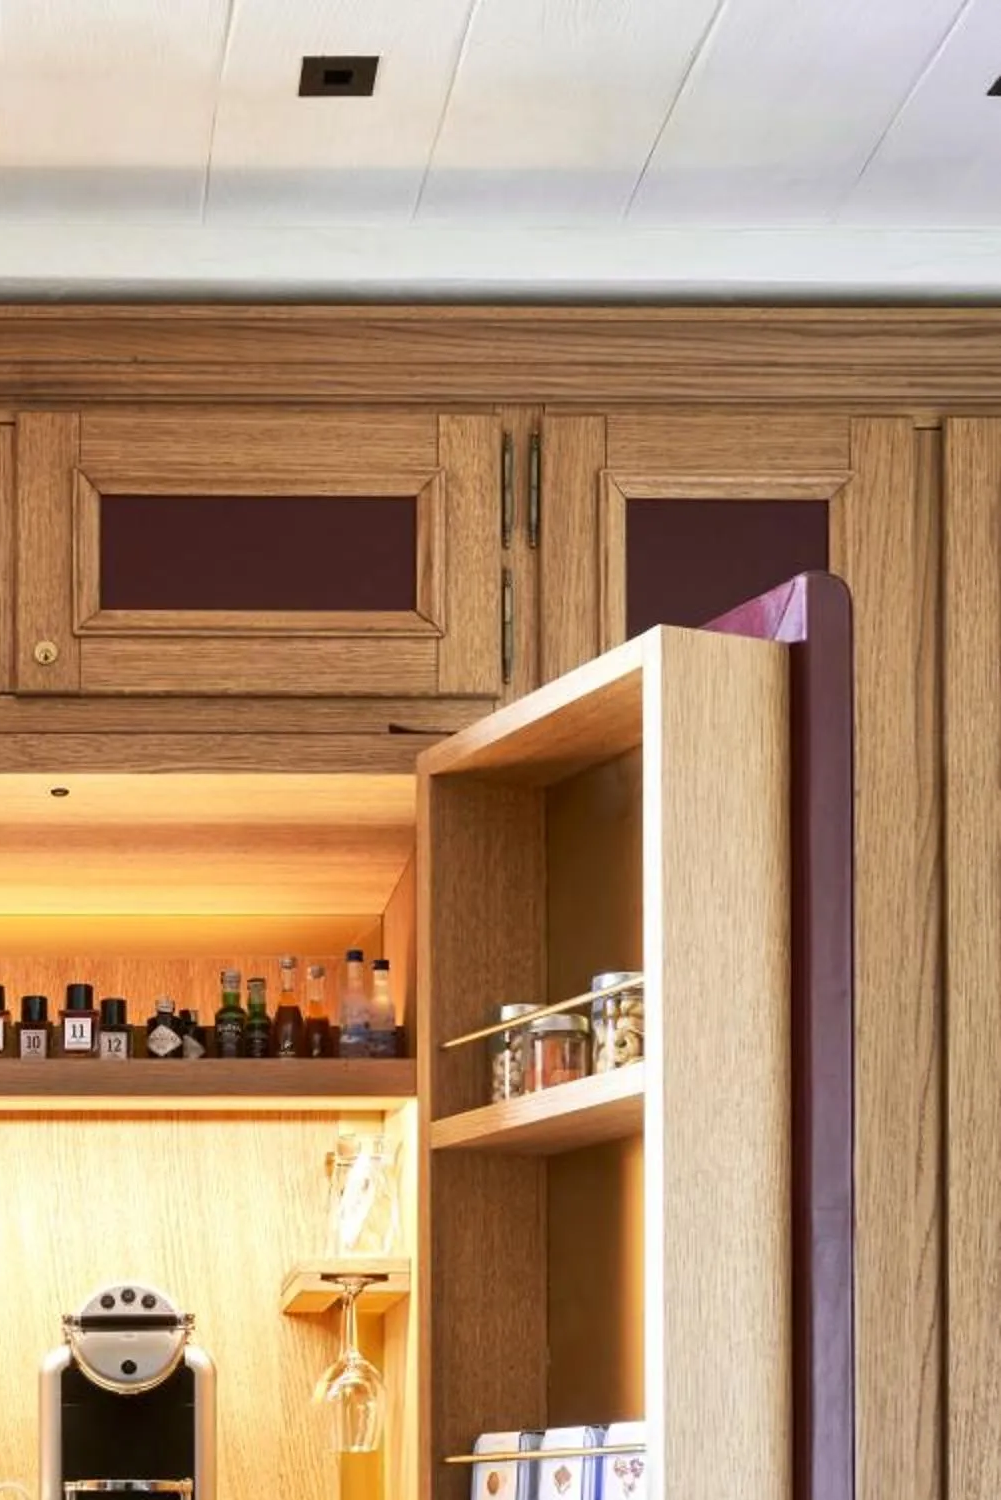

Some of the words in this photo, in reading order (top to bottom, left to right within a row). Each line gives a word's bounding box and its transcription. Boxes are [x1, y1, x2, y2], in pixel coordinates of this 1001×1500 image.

[71, 1024, 84, 1038] 11
[26, 1035, 41, 1049] 10
[107, 1038, 122, 1053] 12
